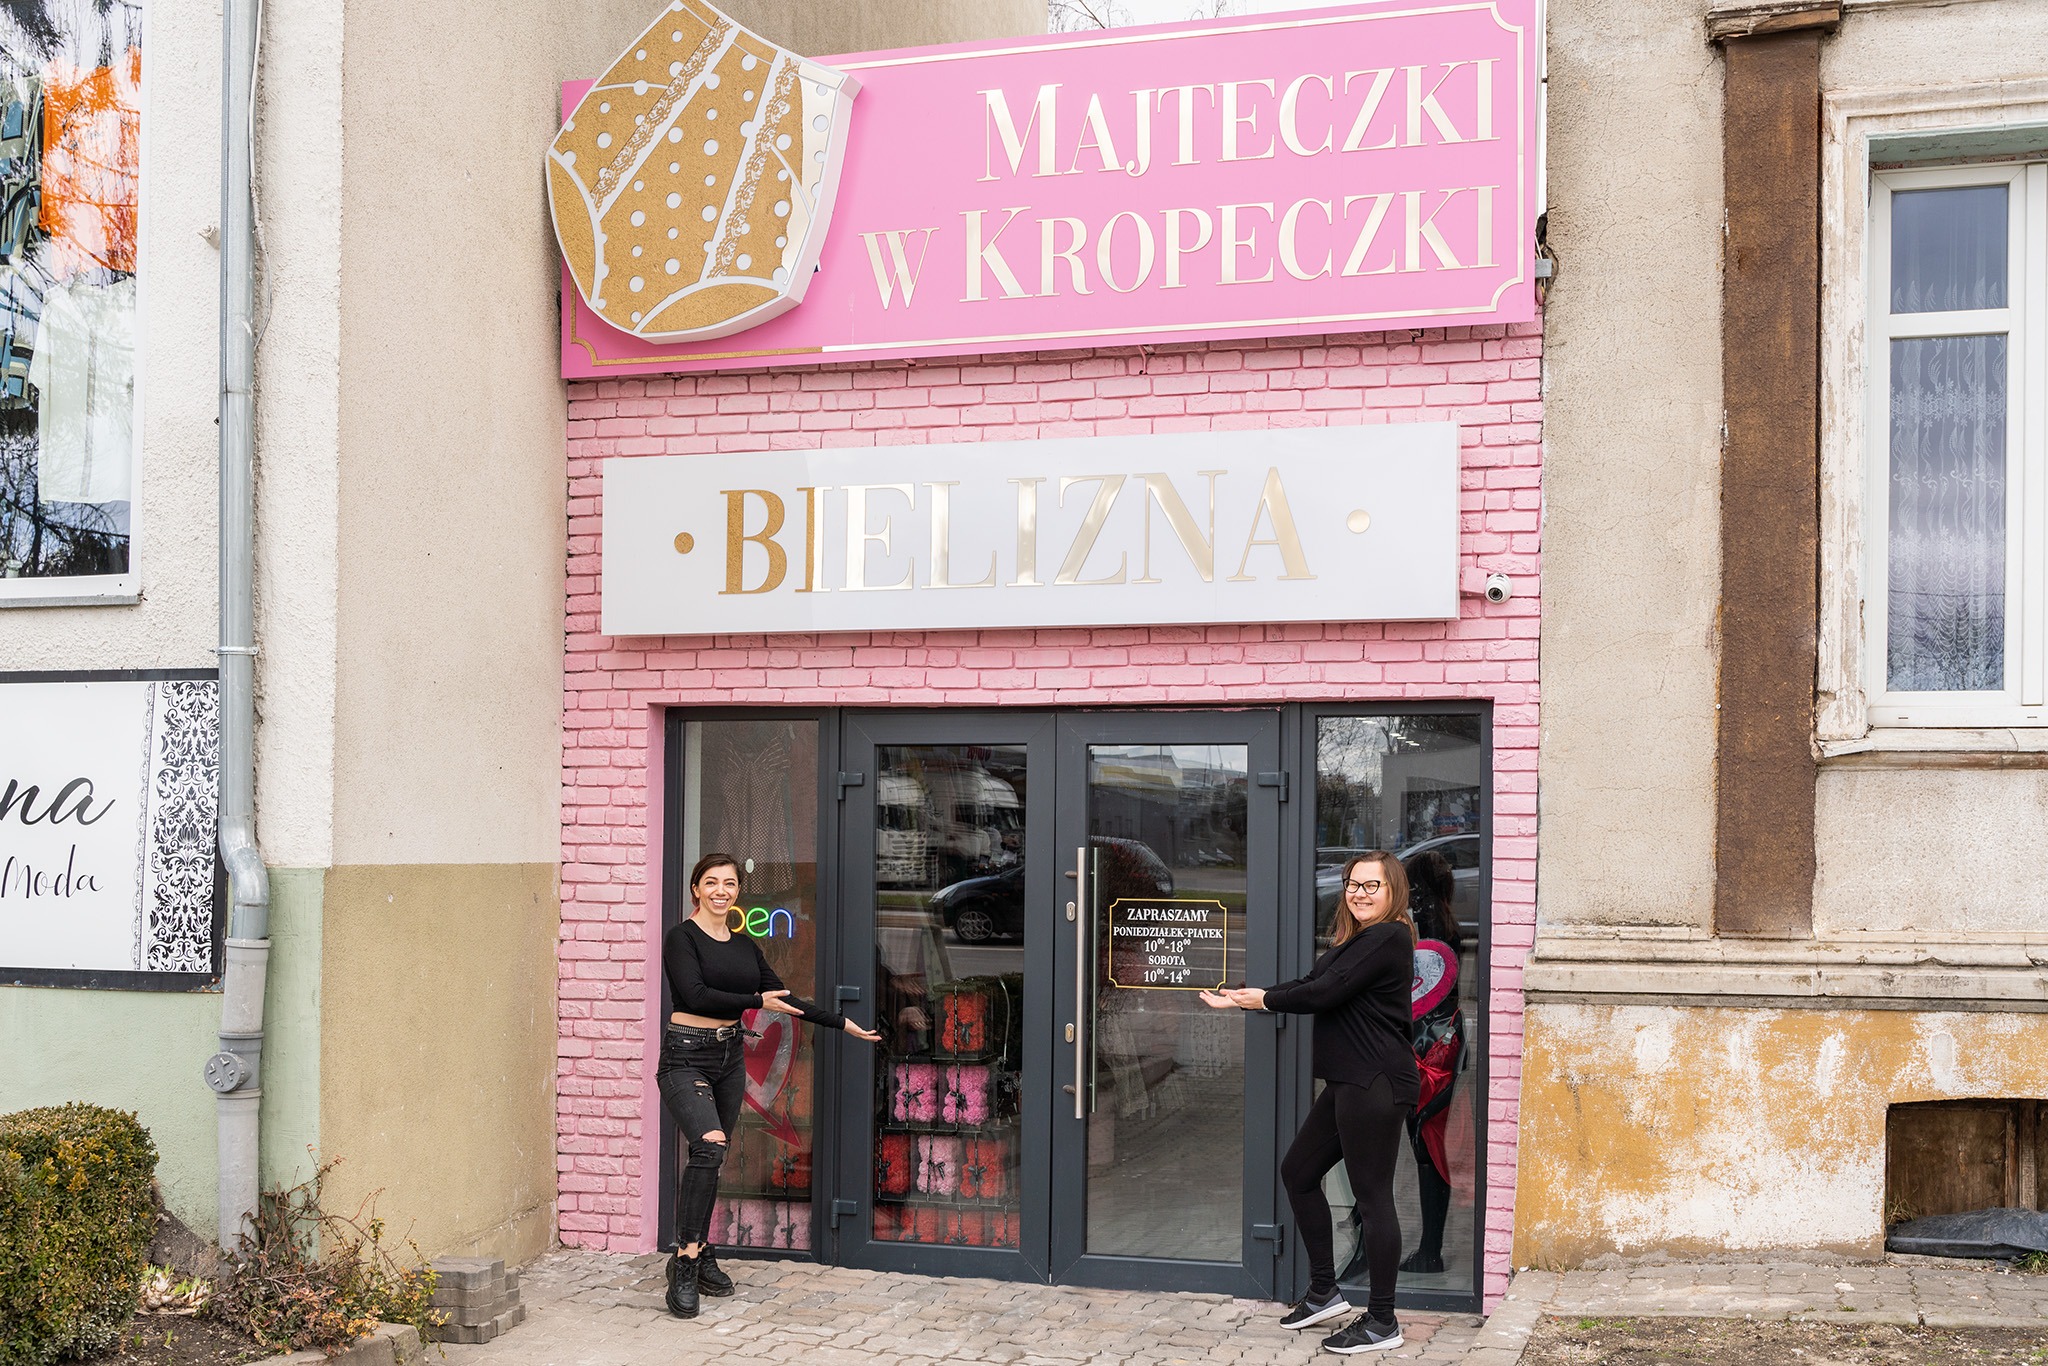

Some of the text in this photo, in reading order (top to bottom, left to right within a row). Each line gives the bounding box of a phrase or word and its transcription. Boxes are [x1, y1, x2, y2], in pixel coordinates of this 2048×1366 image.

[976, 58, 1501, 182] MAJTECZKI
[959, 185, 1501, 302] KROPECZKI
[718, 465, 1319, 596] BIELIZNA
[1, 843, 104, 899] Moda
[1113, 926, 1223, 939] PONIEDZIAŁEK-PIĄTEK
[1127, 908, 1209, 922] ZAPRASZAMY
[1148, 955, 1186, 966] SOBOTA
